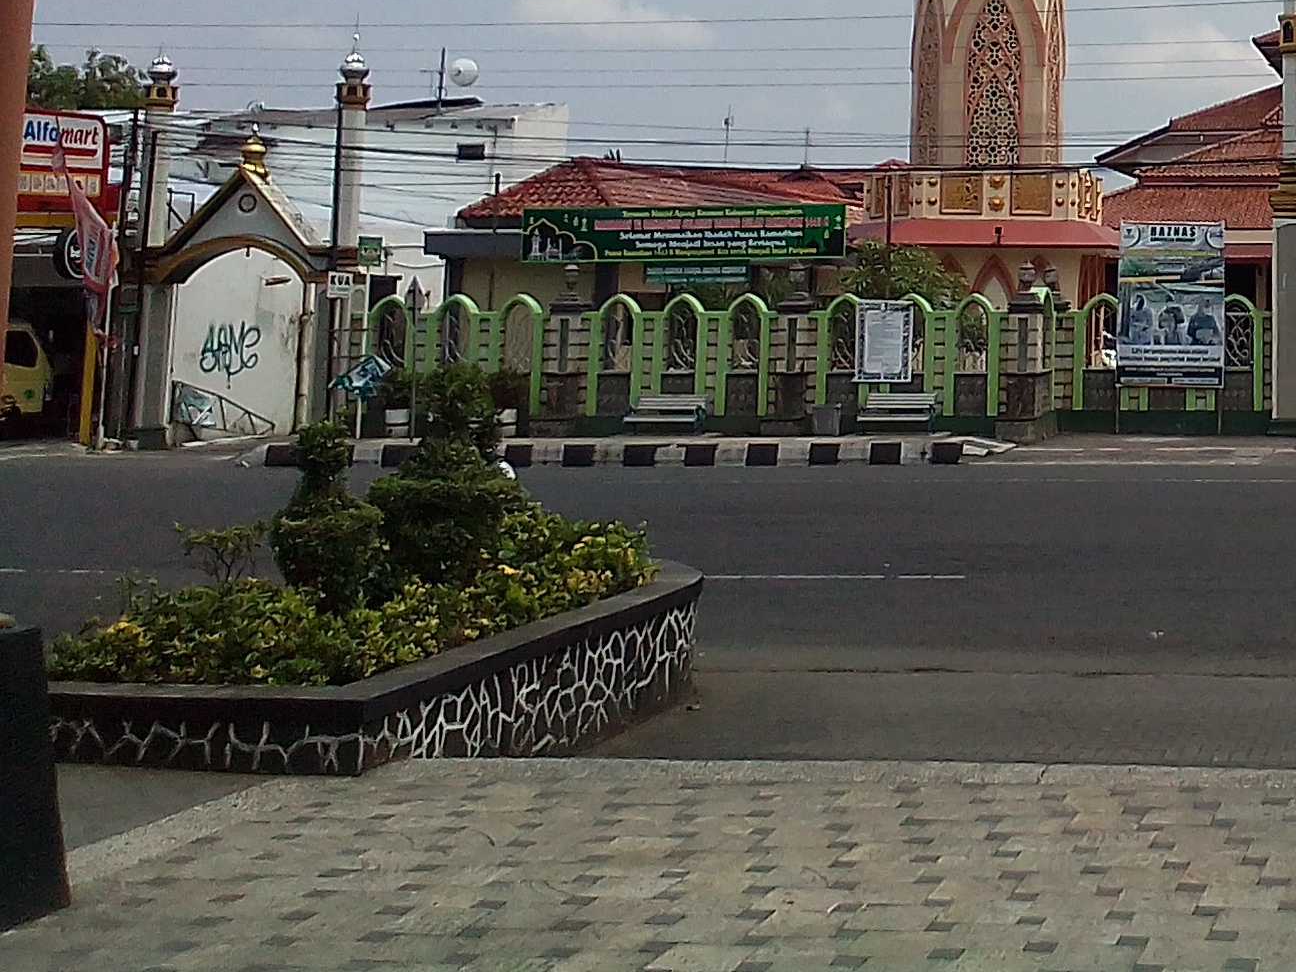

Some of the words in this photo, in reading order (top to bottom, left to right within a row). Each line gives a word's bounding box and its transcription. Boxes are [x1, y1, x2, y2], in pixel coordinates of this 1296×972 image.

[23, 120, 99, 146] Alfamart
[1150, 226, 1197, 238] BAZNAS
[330, 274, 351, 286] KUA
